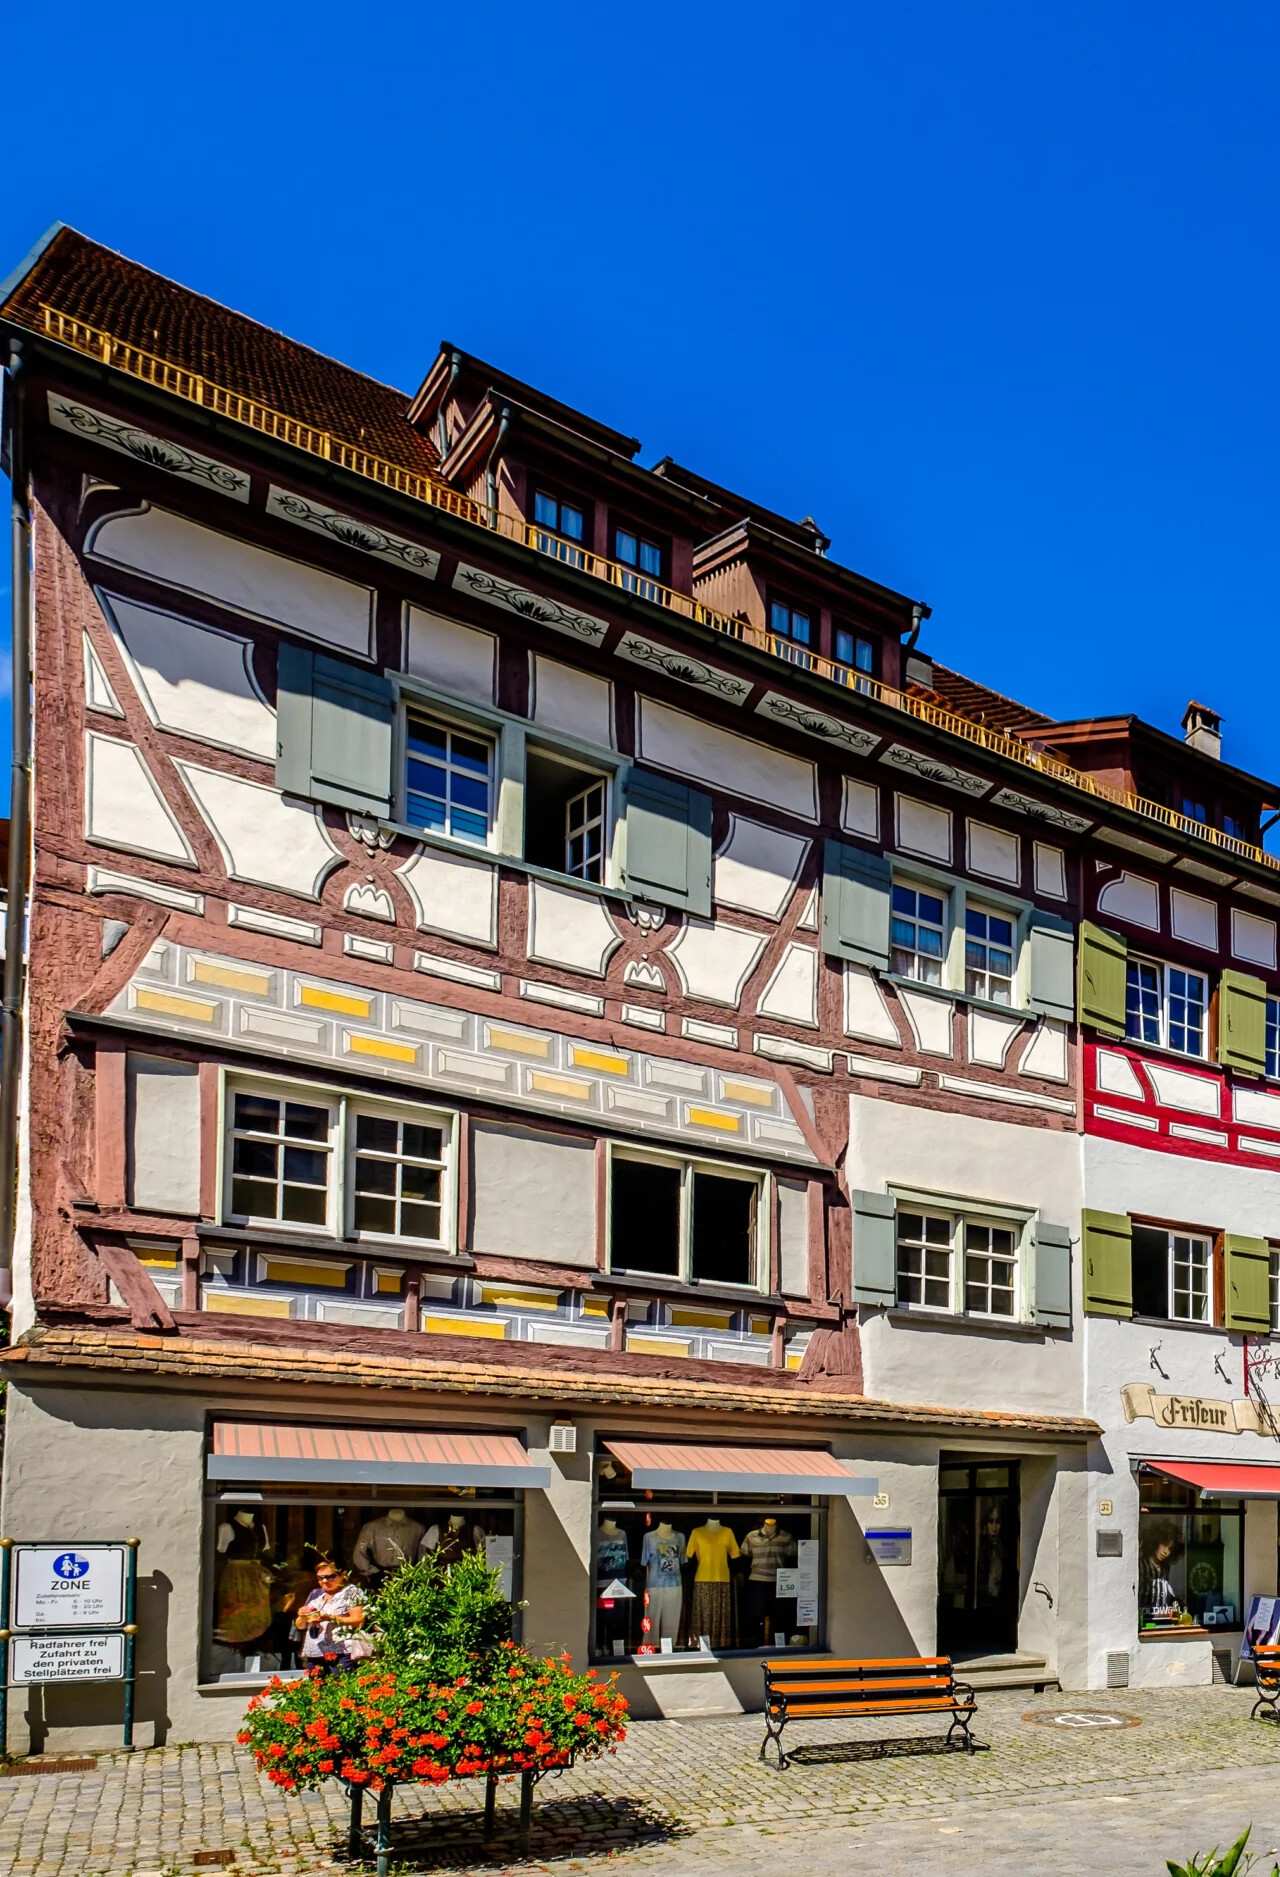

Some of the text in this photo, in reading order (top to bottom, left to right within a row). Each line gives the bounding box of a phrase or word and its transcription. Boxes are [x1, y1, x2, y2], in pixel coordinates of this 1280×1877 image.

[875, 1495, 887, 1506] 35
[50, 1580, 91, 1591] ZONE
[779, 1584, 795, 1592] 1,50
[30, 1639, 107, 1649] Radfahrer frei
[40, 1649, 81, 1658] Zufahrt
[33, 1658, 103, 1668] den privaten
[24, 1666, 111, 1678] Stellplätzen frei
